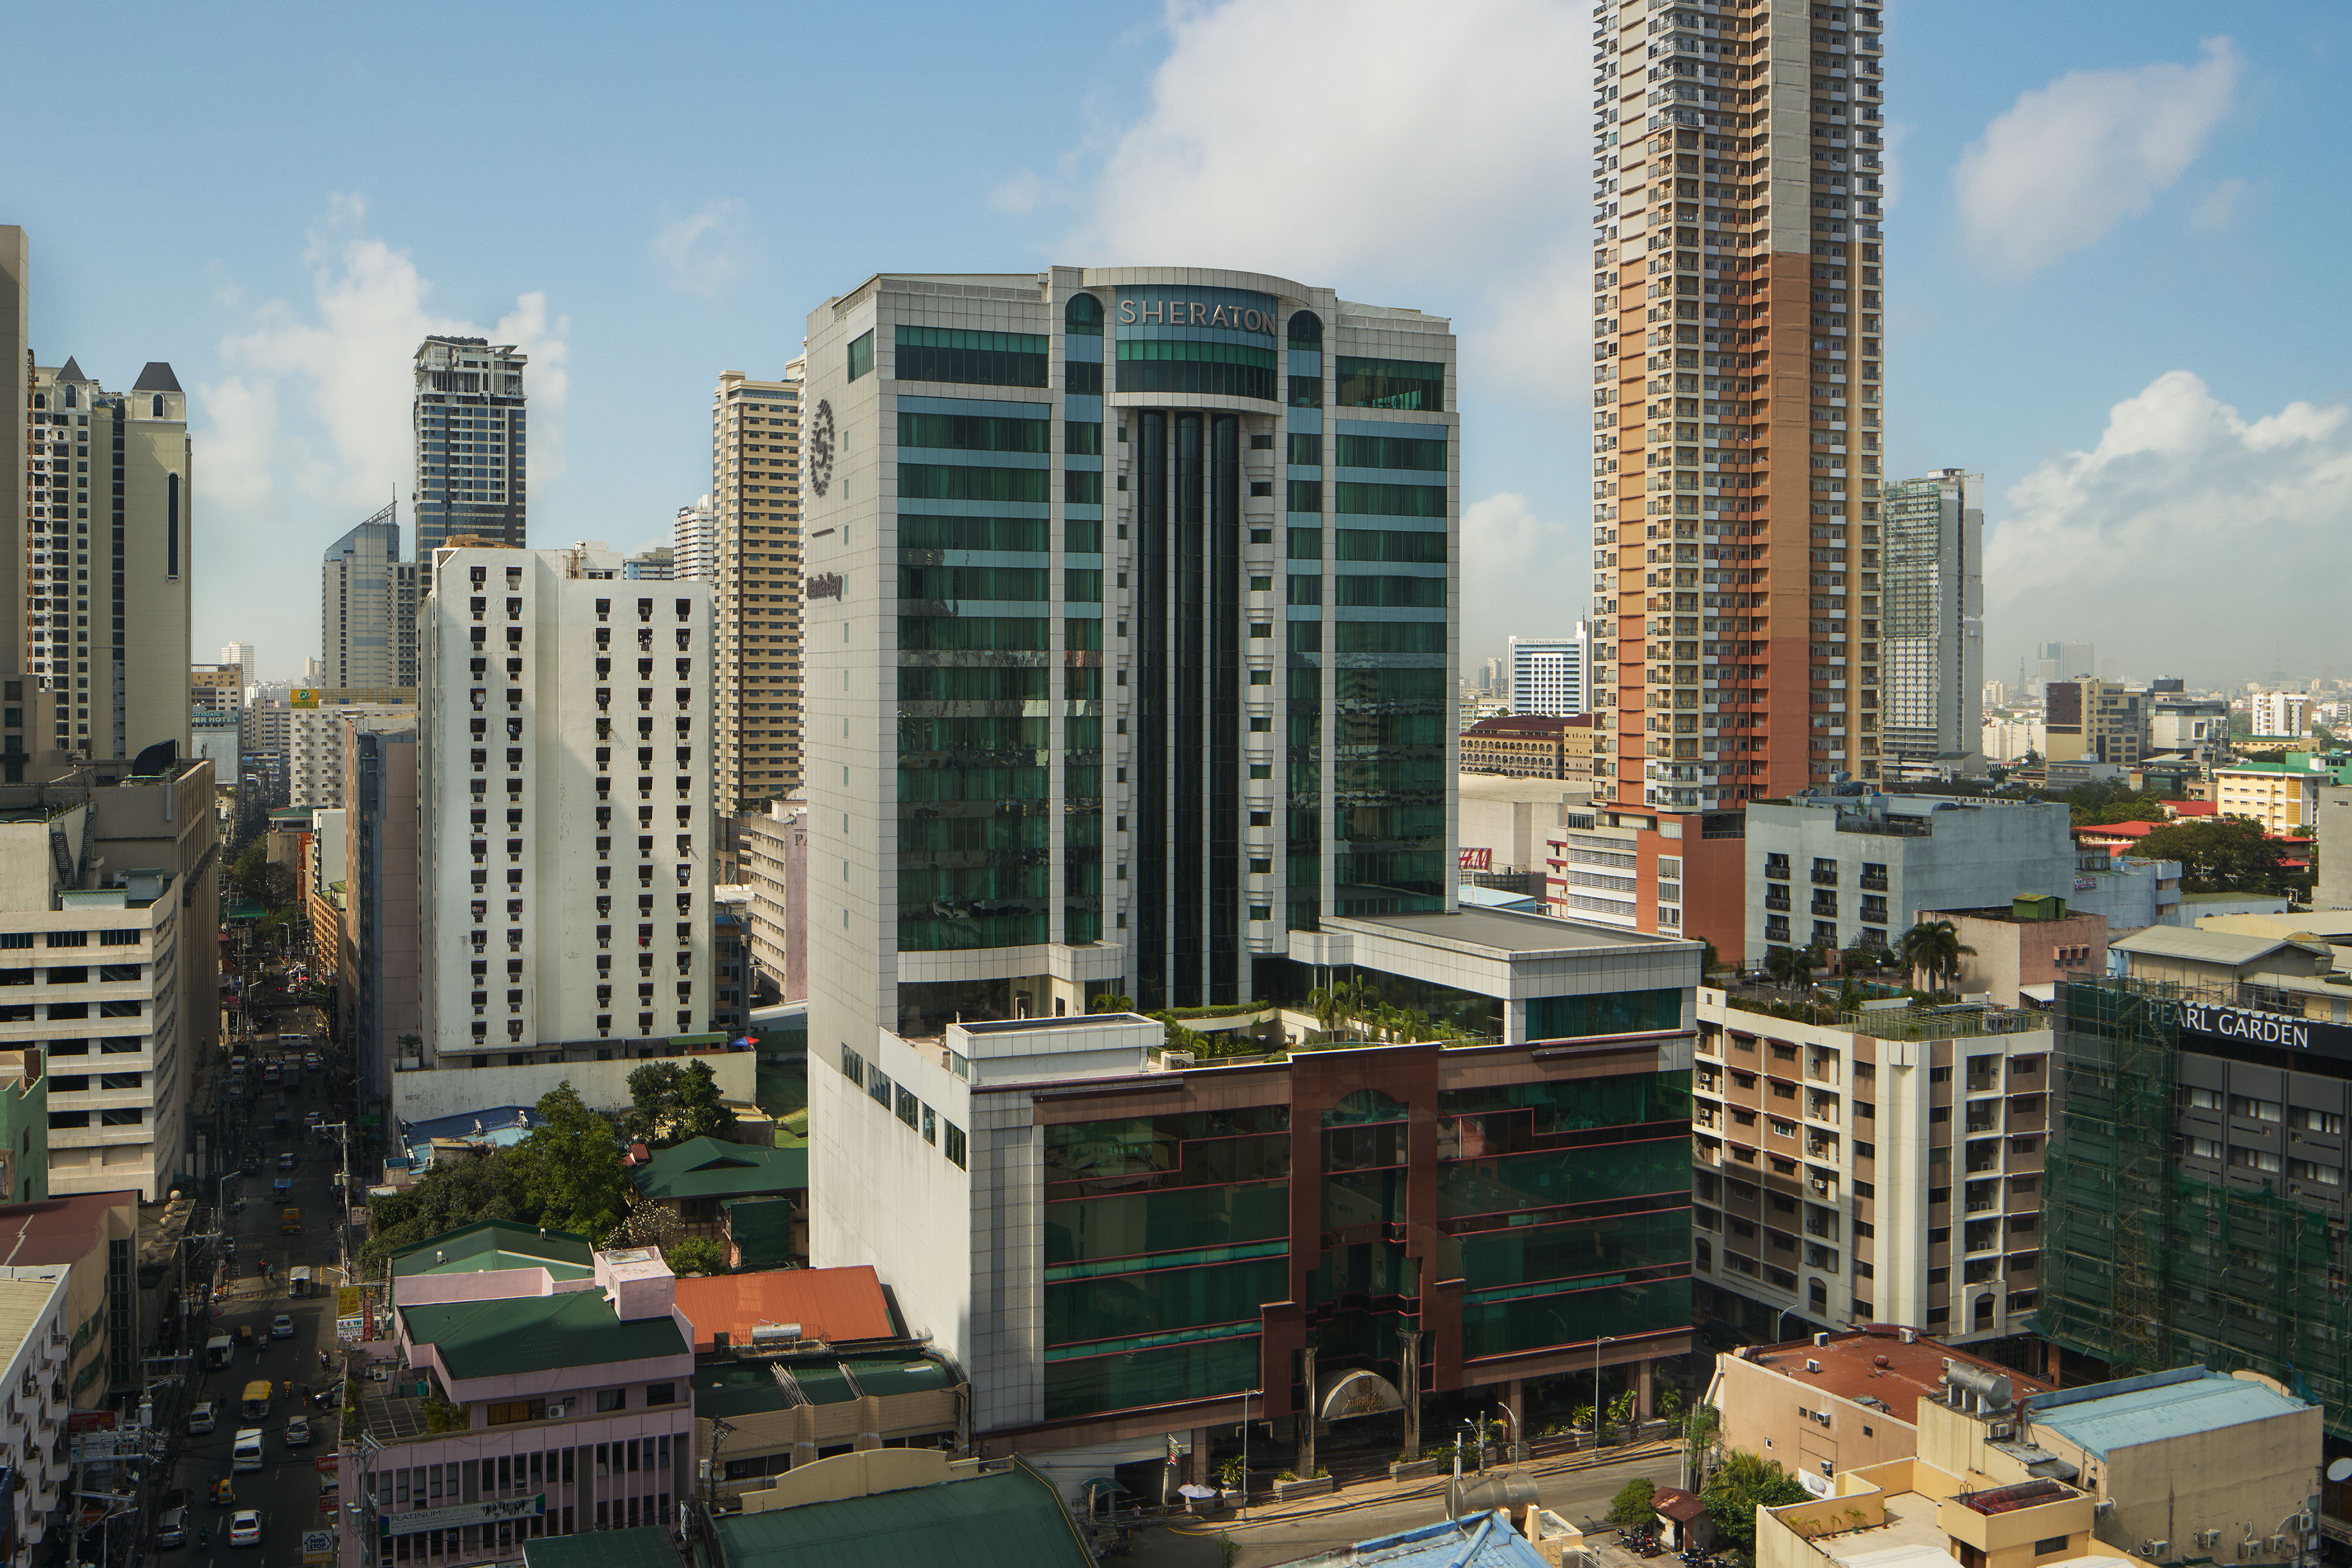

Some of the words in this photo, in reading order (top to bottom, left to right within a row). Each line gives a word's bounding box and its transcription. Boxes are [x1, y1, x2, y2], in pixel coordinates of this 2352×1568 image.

[1119, 300, 1275, 335] SHERATON
[826, 571, 843, 602] Bay
[1458, 848, 1492, 870] H&M
[2149, 1002, 2211, 1032] PEARL
[2219, 1014, 2308, 1048] GARDEN
[312, 1553, 333, 1563] HOURS
